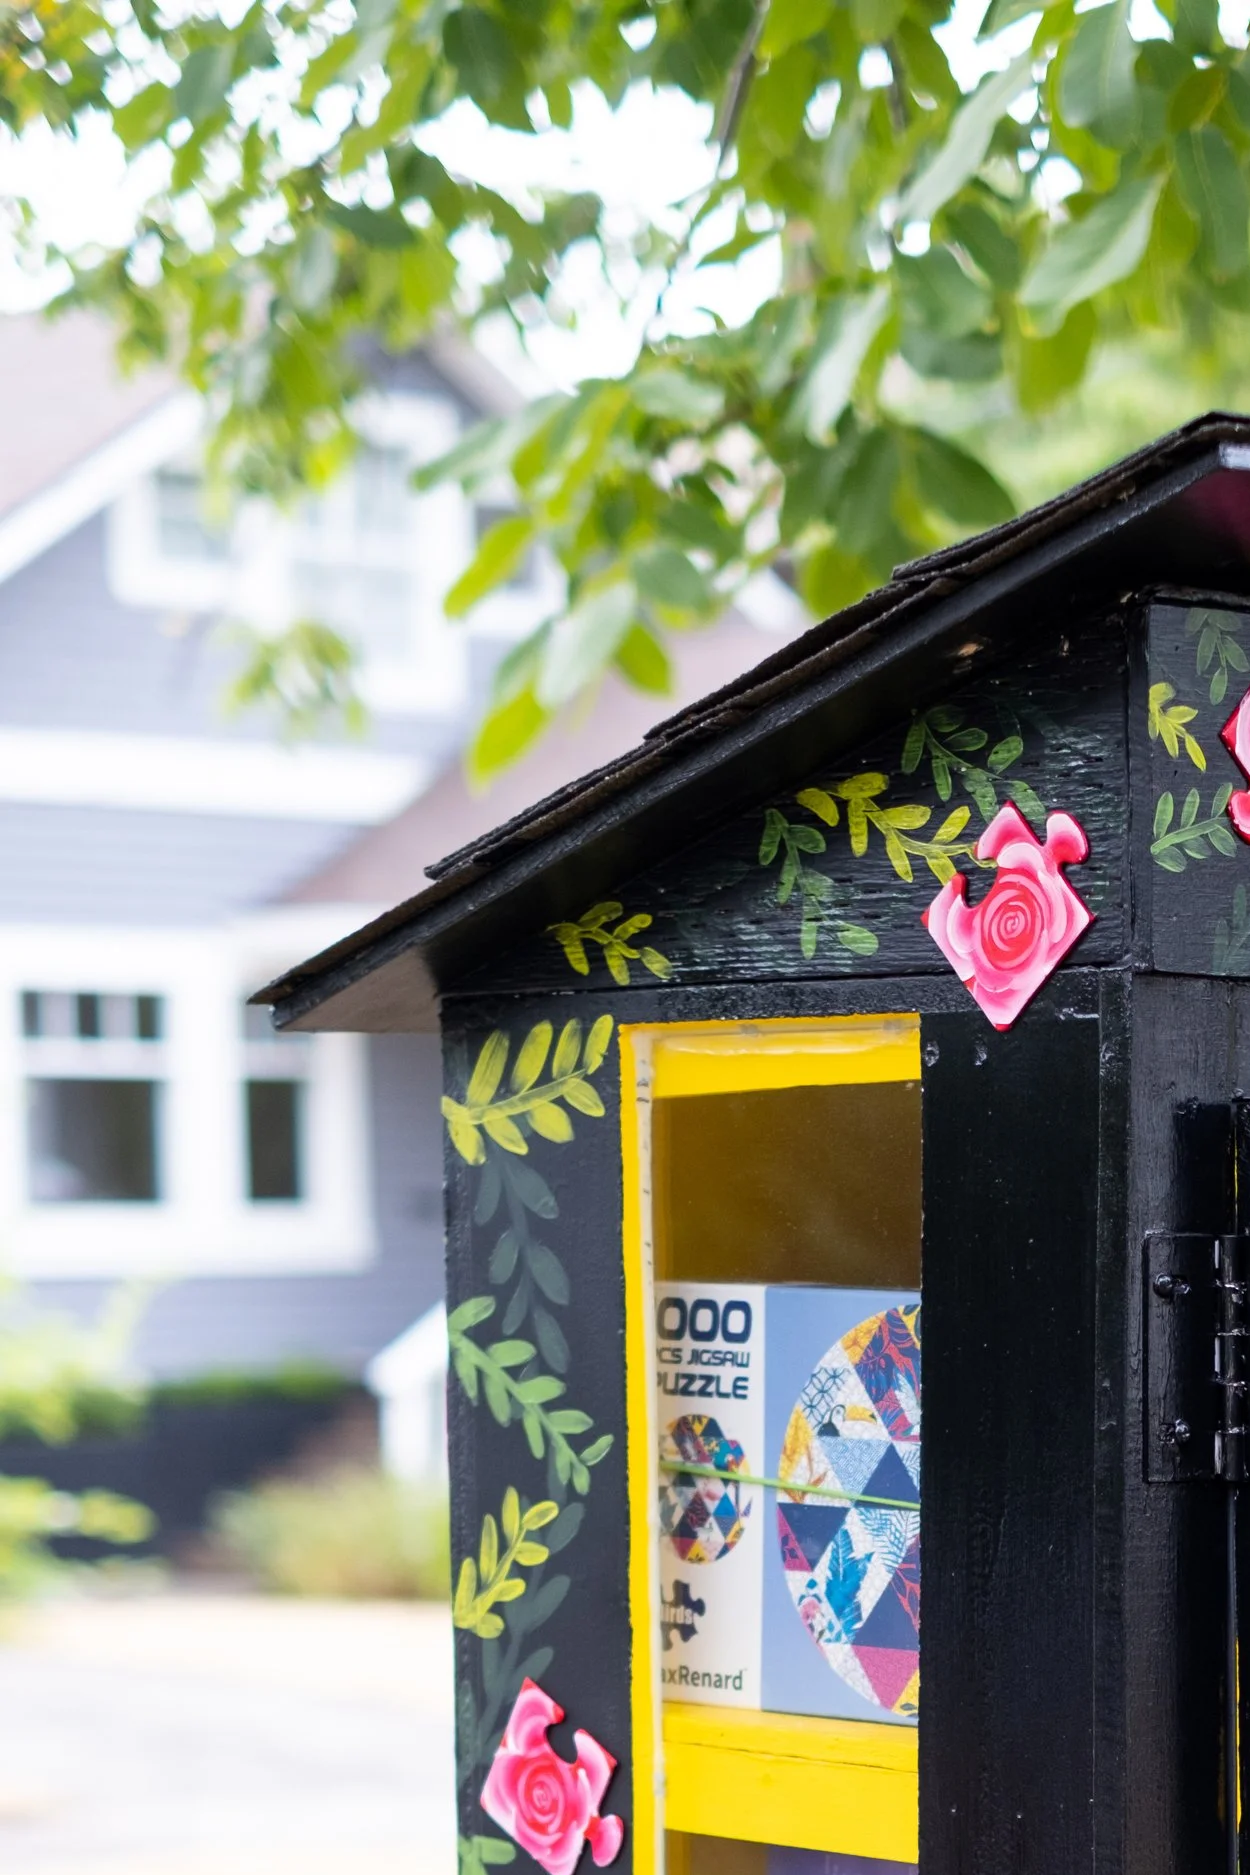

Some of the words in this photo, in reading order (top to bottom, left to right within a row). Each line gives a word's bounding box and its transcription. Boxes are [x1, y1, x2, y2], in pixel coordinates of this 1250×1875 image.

[656, 1296, 752, 1344] 000
[656, 1346, 683, 1364] CS
[687, 1348, 751, 1368] JIGSAW
